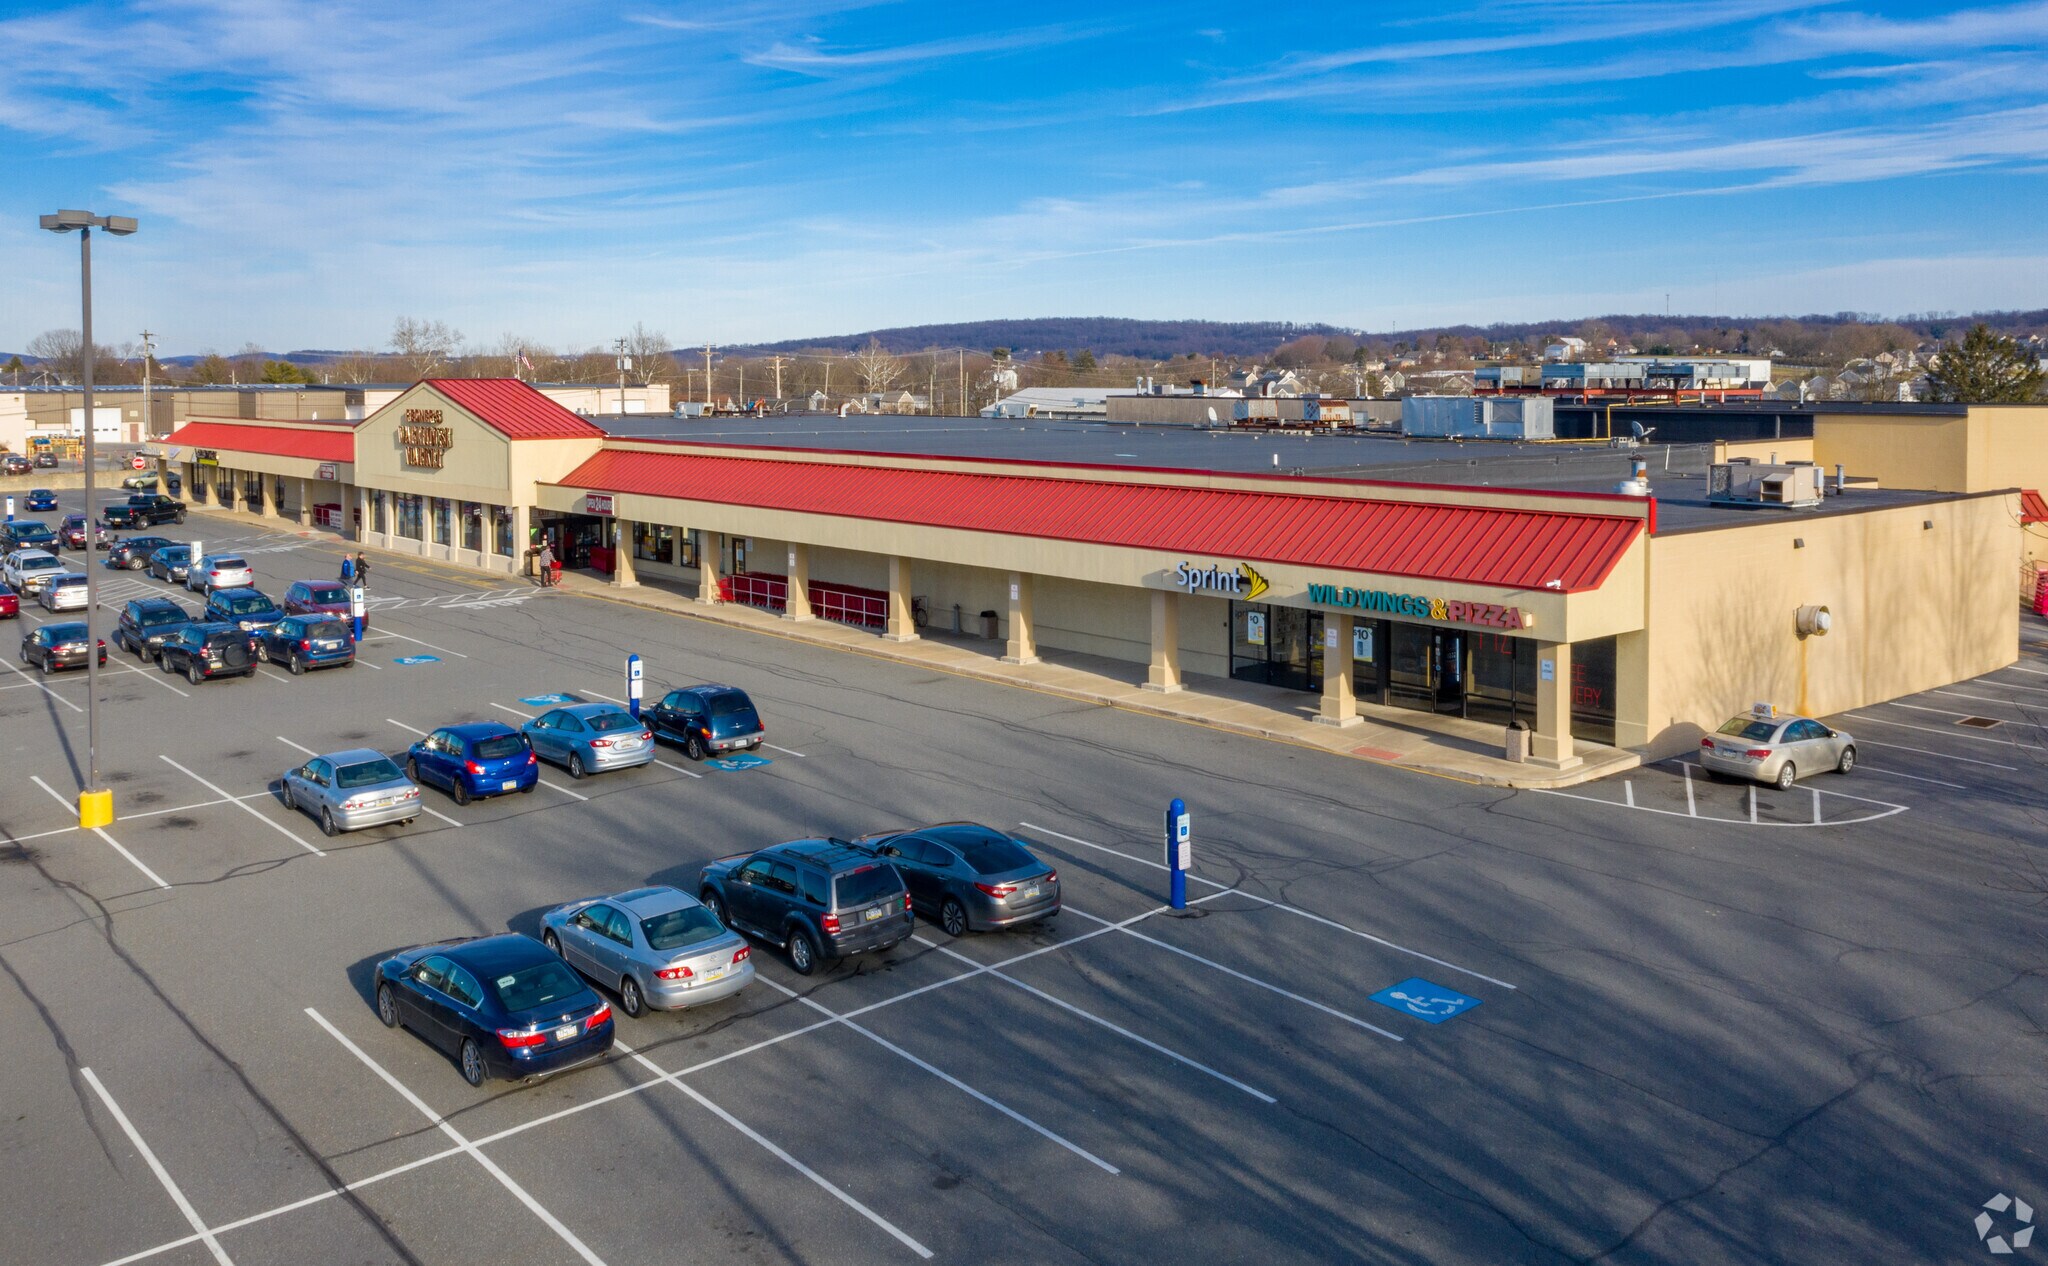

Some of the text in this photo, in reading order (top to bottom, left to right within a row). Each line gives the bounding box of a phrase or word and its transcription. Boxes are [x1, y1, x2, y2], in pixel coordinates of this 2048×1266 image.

[1176, 560, 1243, 594] Sprint
[1430, 598, 1448, 620] &
[1449, 599, 1525, 630] PIZZA
